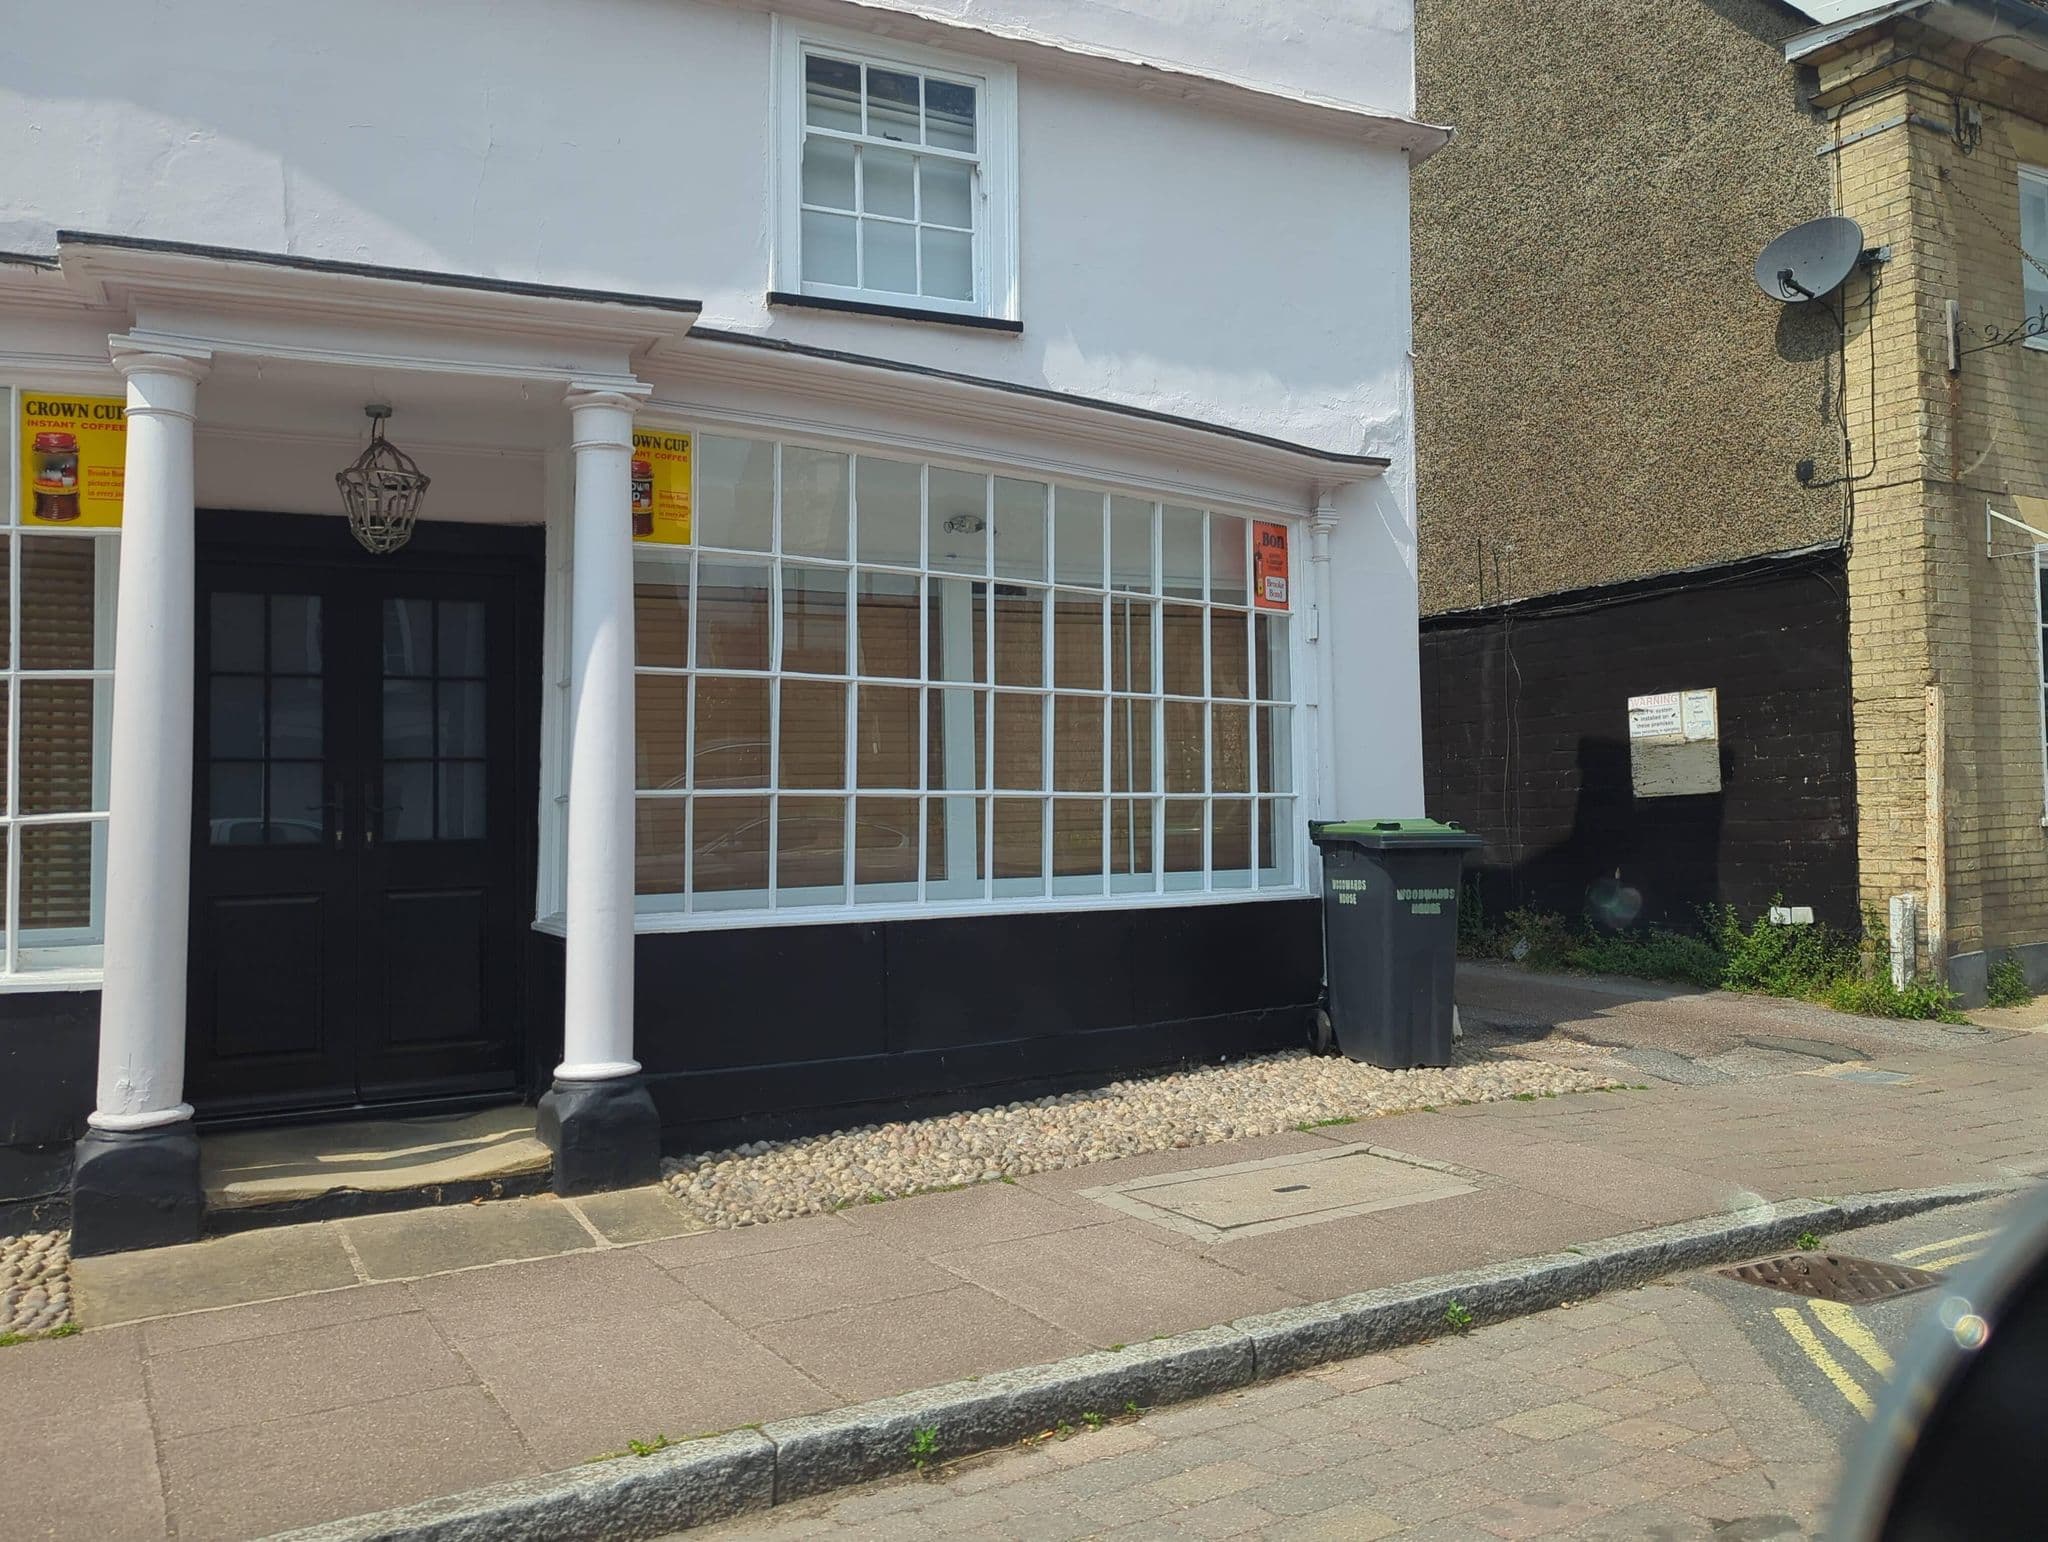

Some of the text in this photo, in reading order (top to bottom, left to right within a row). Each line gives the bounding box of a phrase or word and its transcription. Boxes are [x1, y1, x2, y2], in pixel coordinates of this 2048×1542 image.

[26, 400, 89, 418] CROWN
[27, 418, 127, 431] INSTANT COFFEE
[664, 438, 689, 452] CUP
[655, 452, 688, 463] COFFEE
[1630, 694, 1678, 707] WARNING
[1339, 893, 1357, 905] HOUSE
[1396, 888, 1456, 901] WOODWARDS
